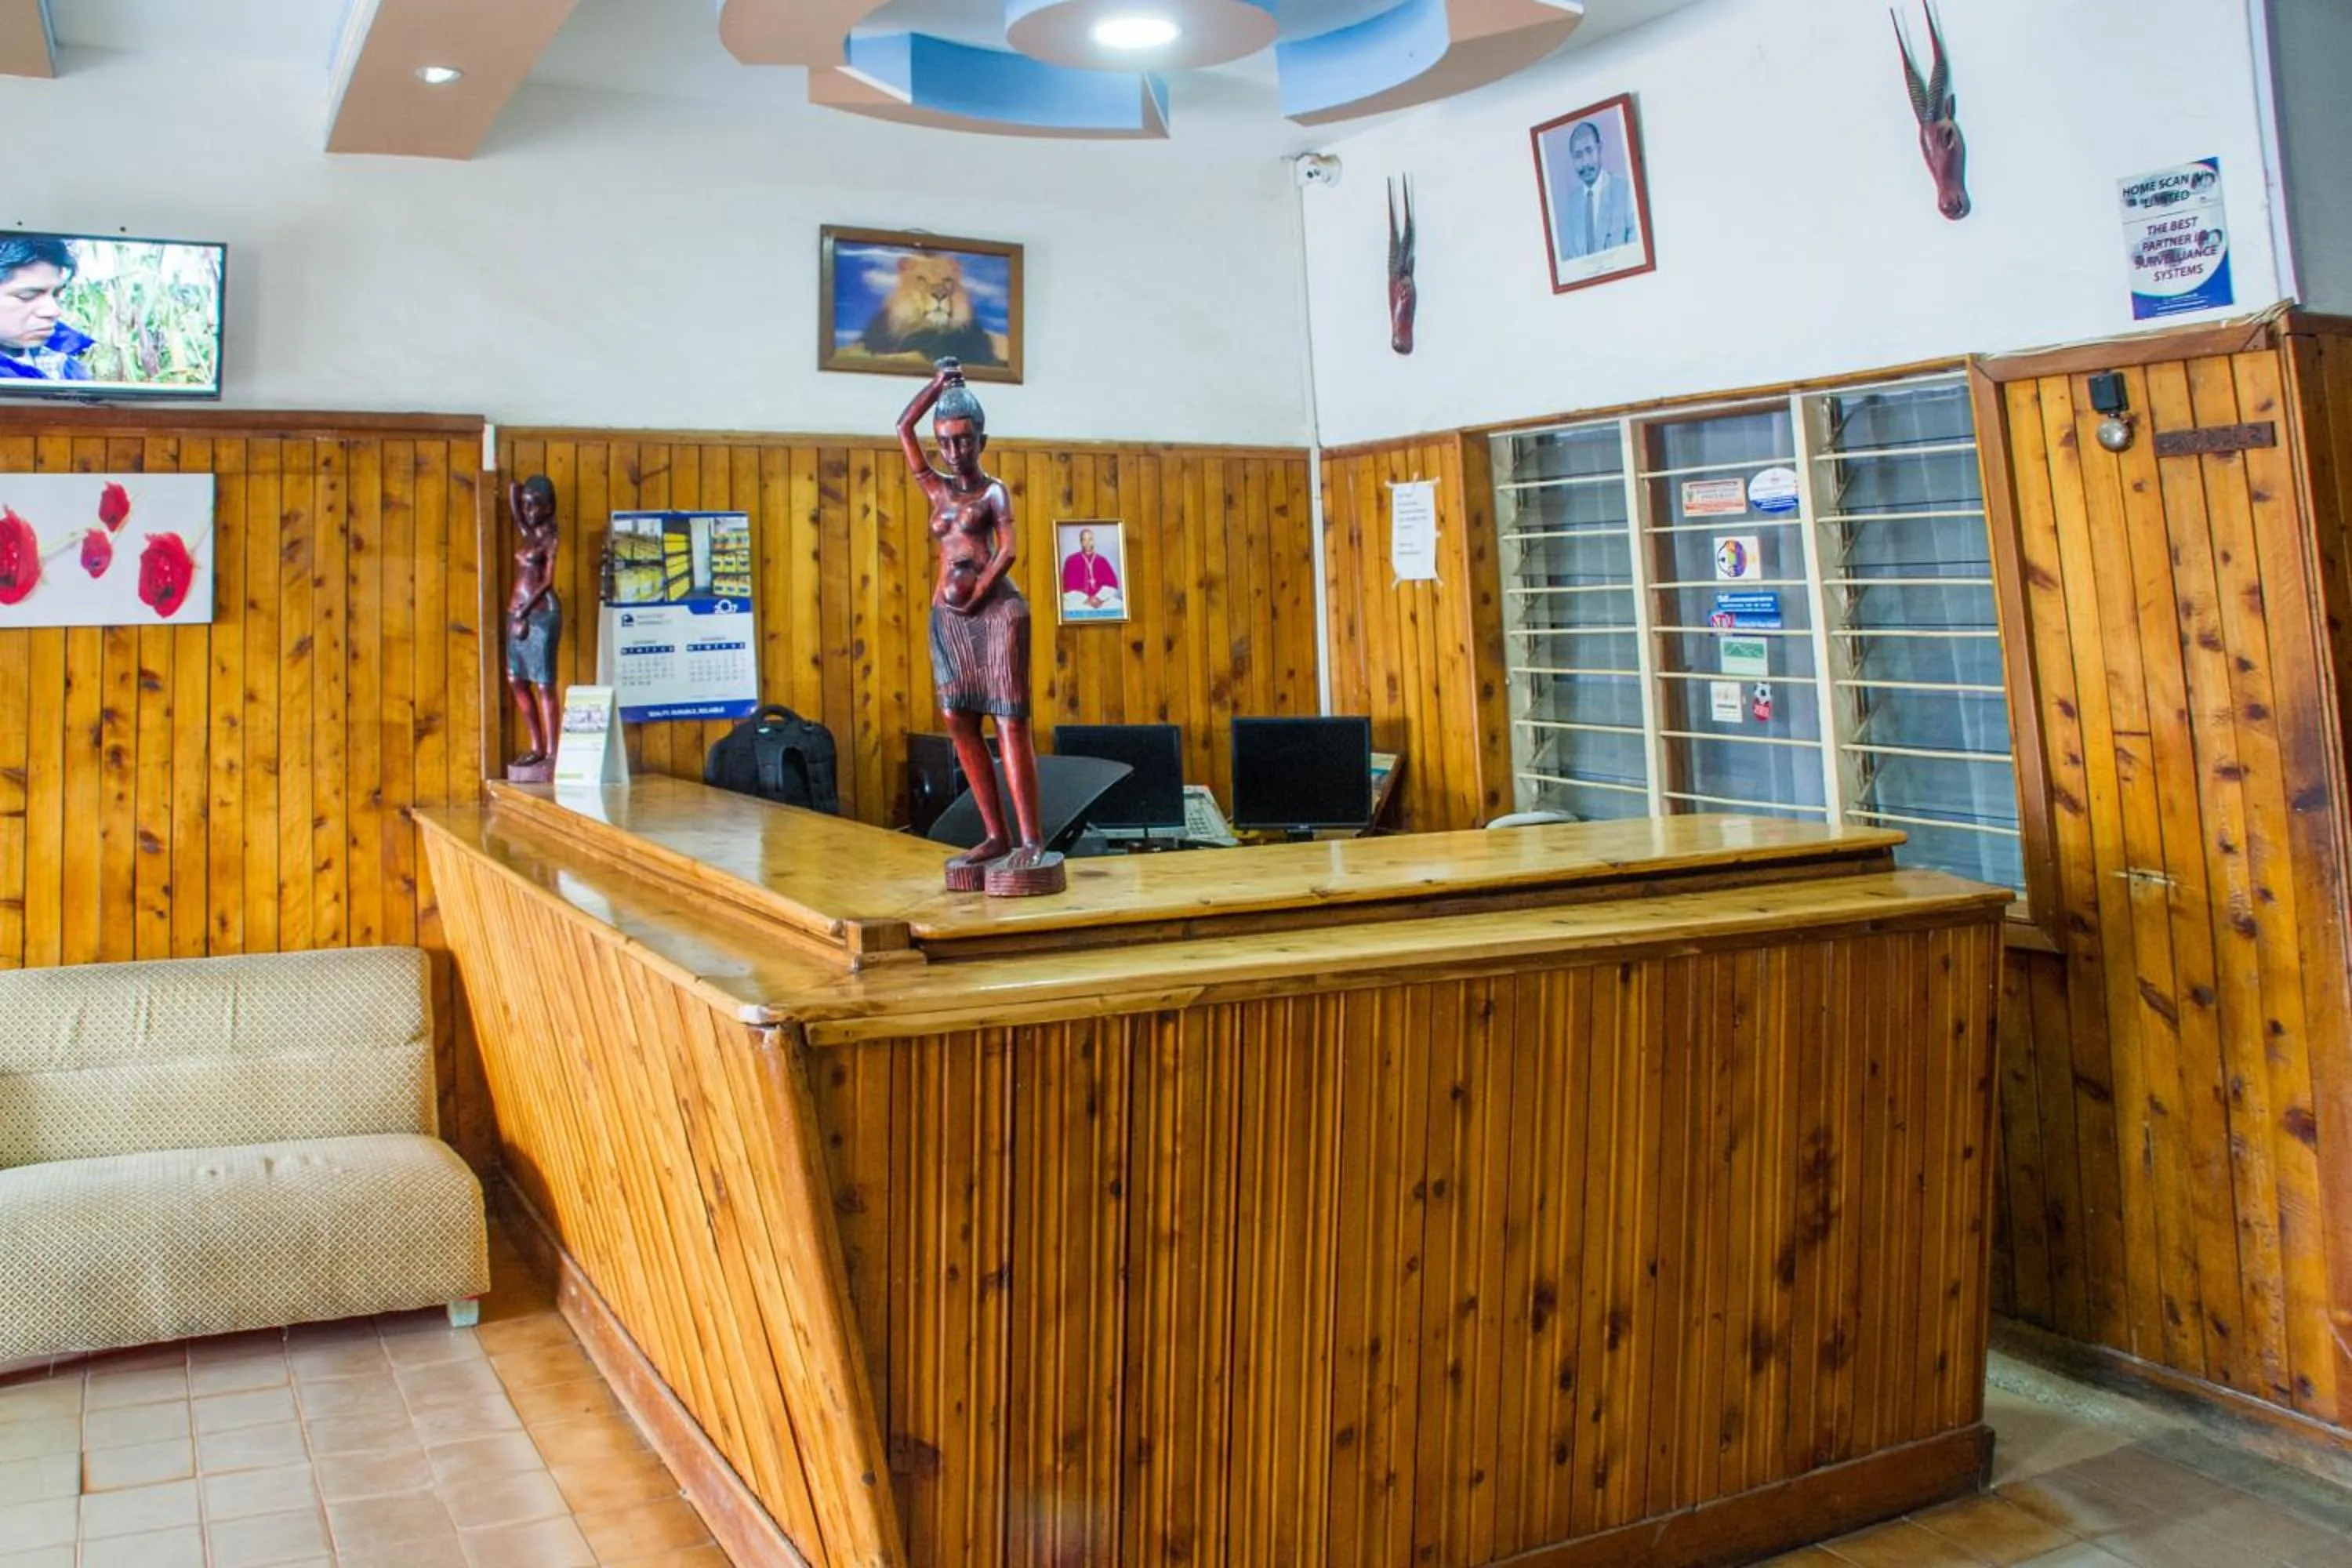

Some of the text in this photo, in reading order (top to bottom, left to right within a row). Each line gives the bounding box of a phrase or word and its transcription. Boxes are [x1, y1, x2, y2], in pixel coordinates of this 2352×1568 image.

[2122, 181, 2156, 197] HOME
[2158, 173, 2190, 189] SCAN
[2147, 216, 2198, 236] THE BEST
[2143, 234, 2191, 252] PARTNER
[2154, 263, 2204, 281] SYSTEMS
